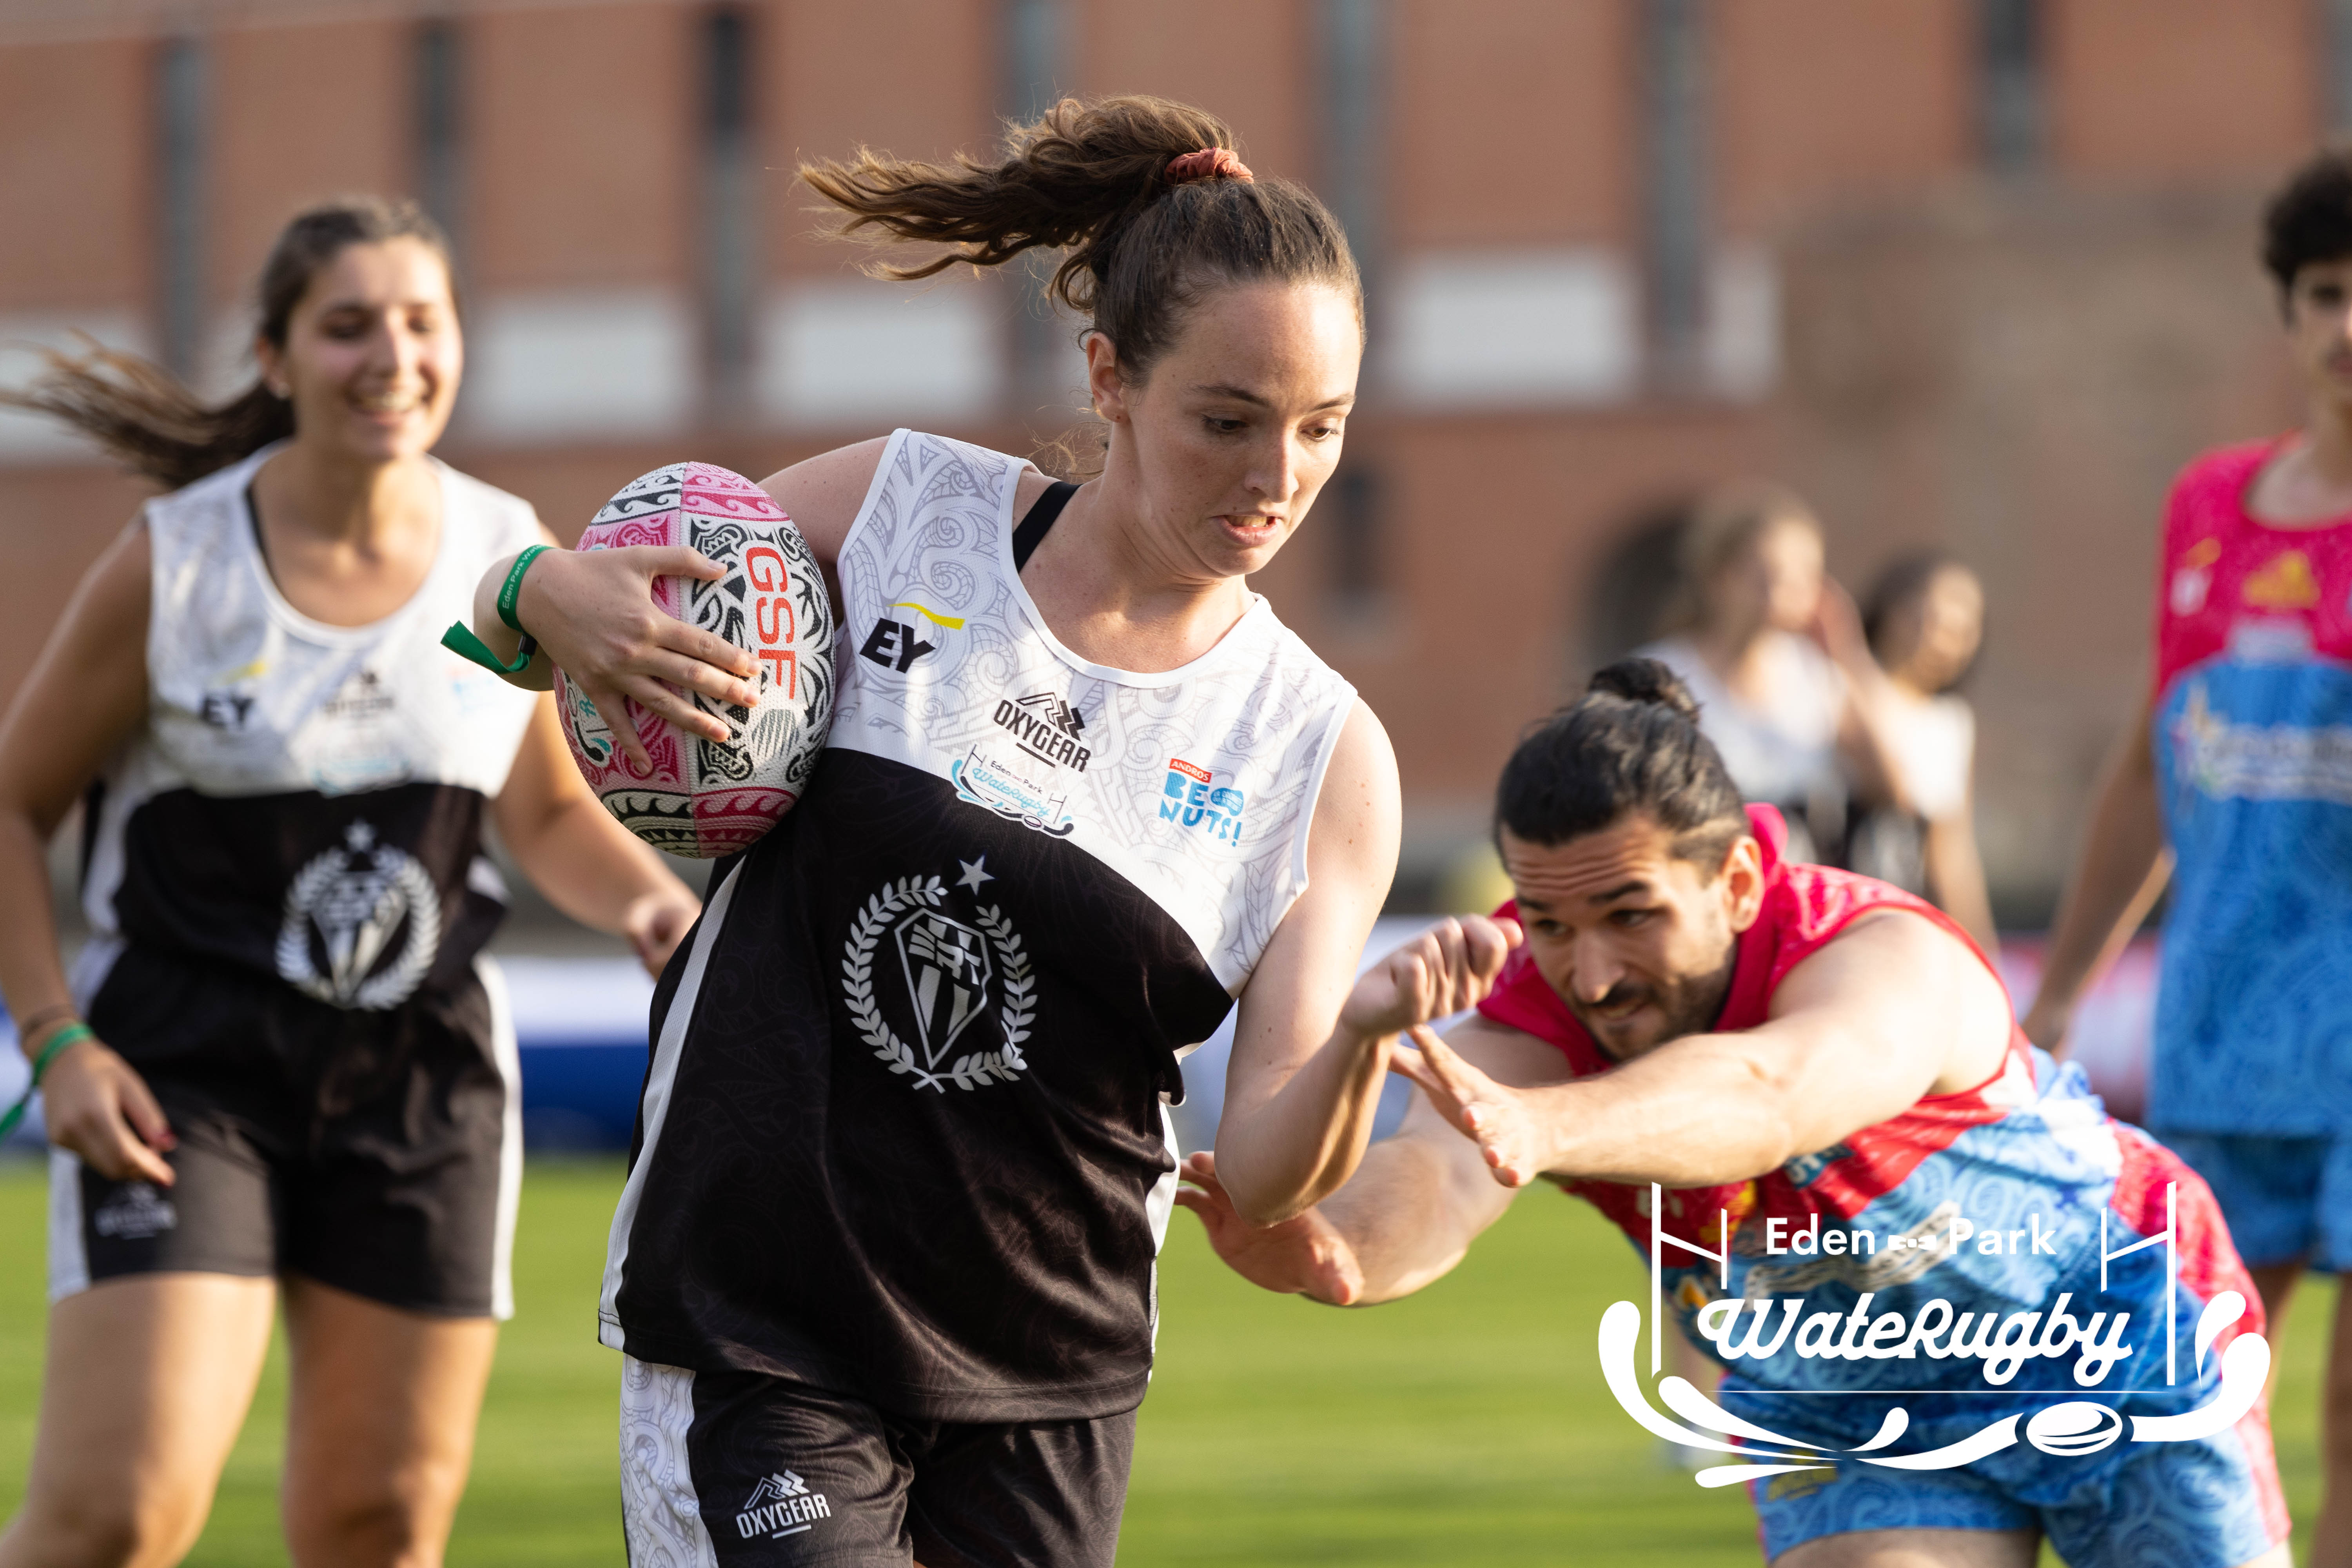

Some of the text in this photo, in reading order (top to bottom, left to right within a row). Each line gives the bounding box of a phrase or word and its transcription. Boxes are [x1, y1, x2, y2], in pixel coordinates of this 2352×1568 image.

[502, 584, 514, 609] Eden
[510, 561, 524, 583] Park
[746, 546, 796, 700] GSF
[859, 617, 936, 674] EY
[993, 699, 1091, 773] OXYGEAR
[991, 760, 1043, 795] Eden Park
[1171, 760, 1209, 782] ANDROS
[1159, 798, 1242, 847] NUTS!
[736, 1494, 831, 1539] OXYGEAR
